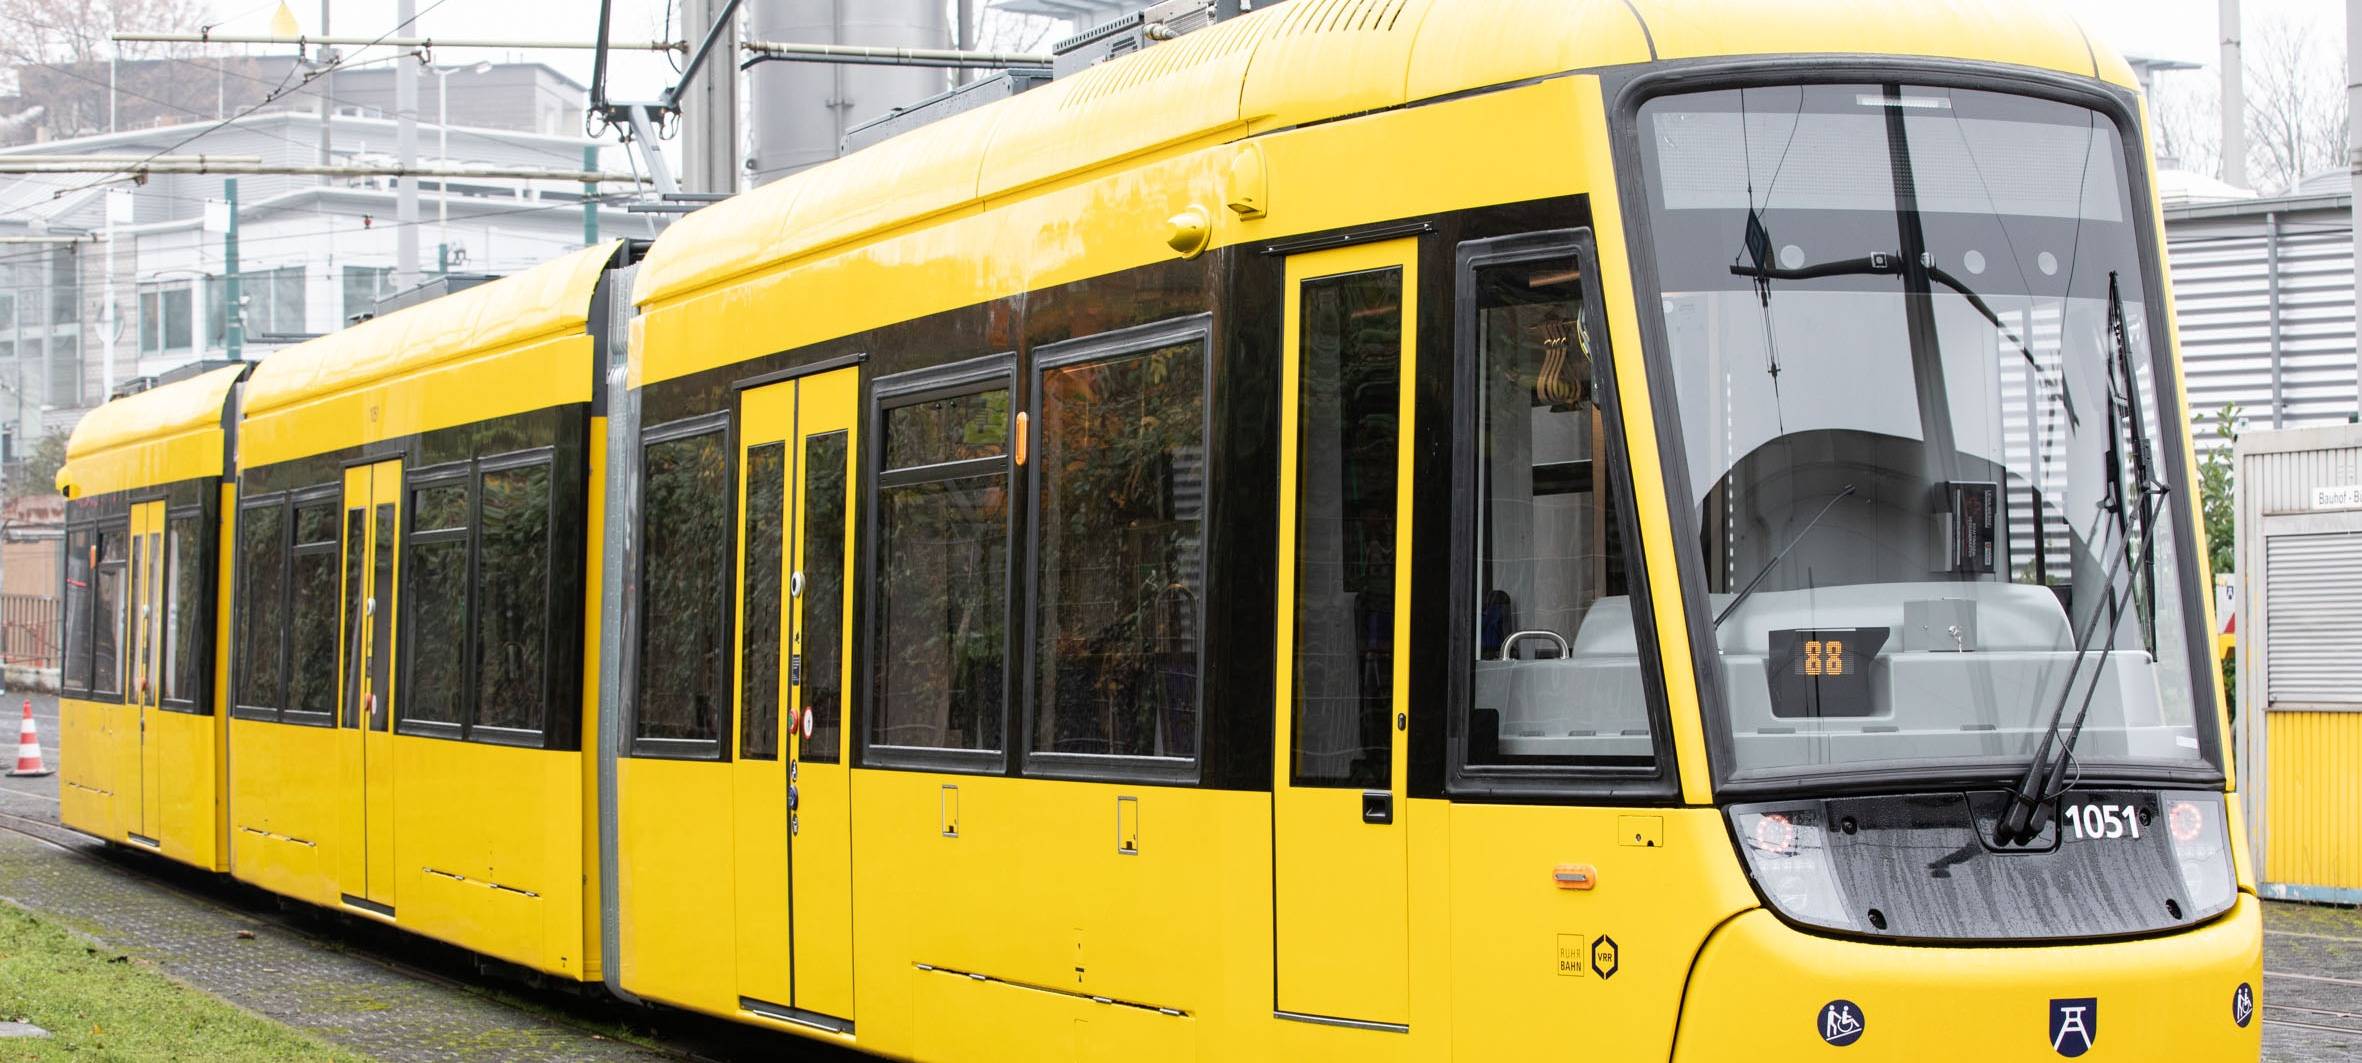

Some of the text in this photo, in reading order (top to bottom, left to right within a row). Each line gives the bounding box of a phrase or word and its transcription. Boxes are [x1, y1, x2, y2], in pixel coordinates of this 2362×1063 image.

[1804, 640, 1842, 676] 88
[2064, 804, 2140, 839] 1051
[1560, 947, 1581, 959] RUHR
[1597, 952, 1613, 962] VRR
[1560, 960, 1582, 972] BAHN
